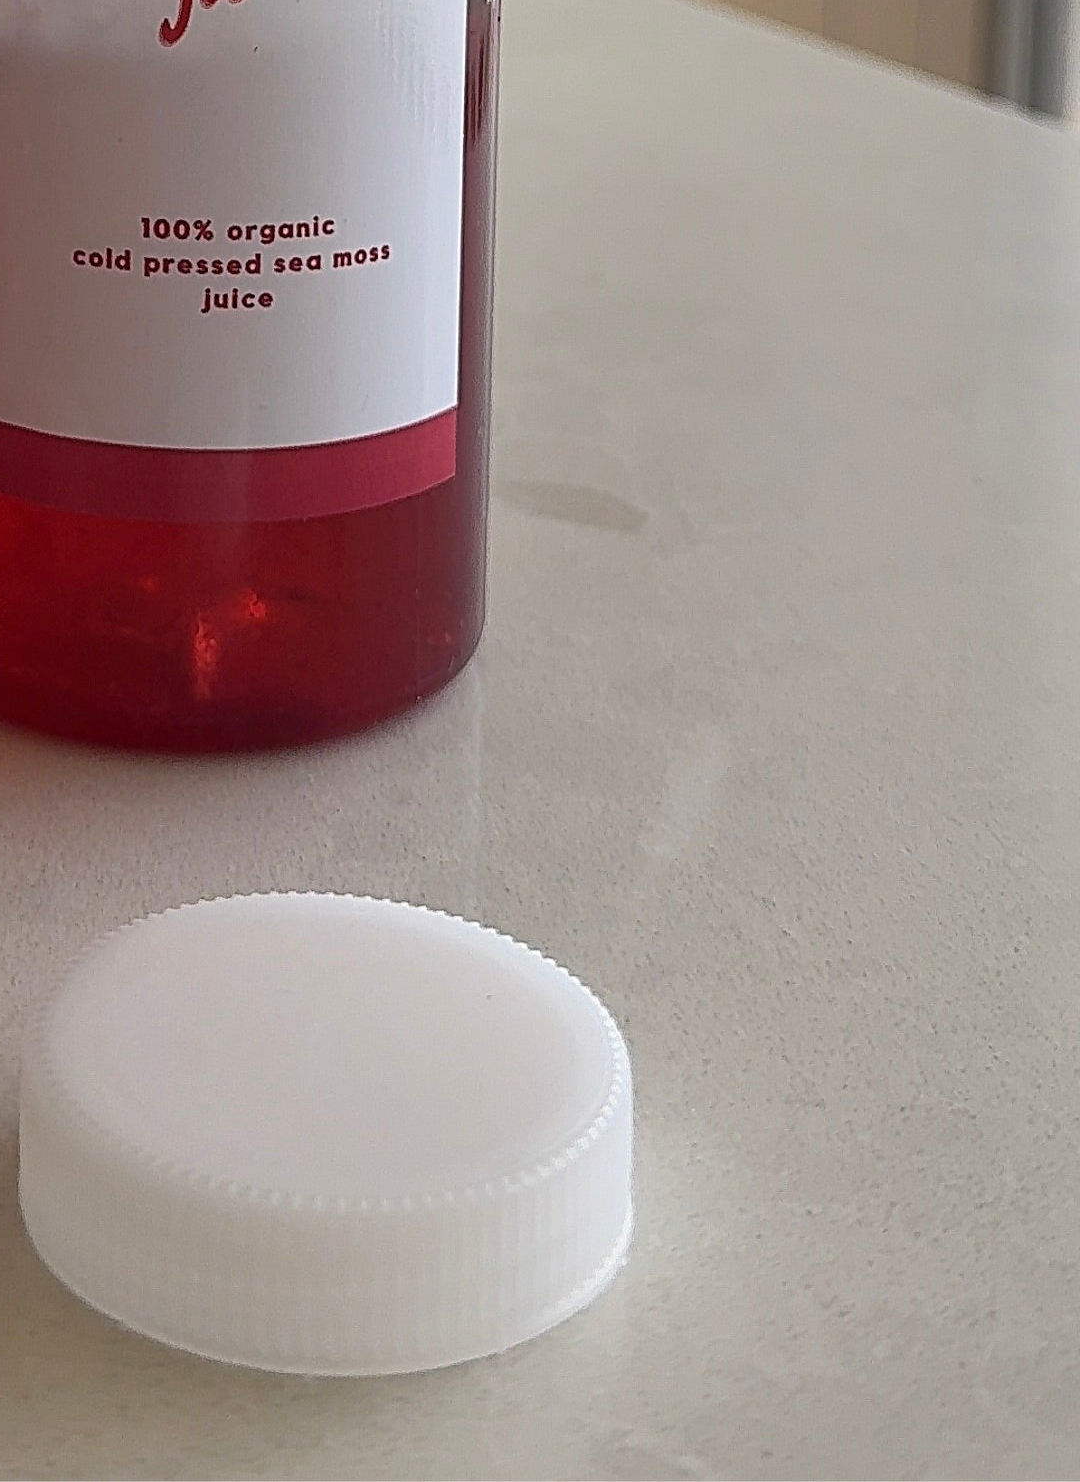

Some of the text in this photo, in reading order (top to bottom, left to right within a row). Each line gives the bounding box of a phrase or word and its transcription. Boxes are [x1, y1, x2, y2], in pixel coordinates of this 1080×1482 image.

[140, 215, 335, 244] 100% organic
[72, 243, 391, 277] cold pressed sea moss
[200, 288, 274, 313] juice
